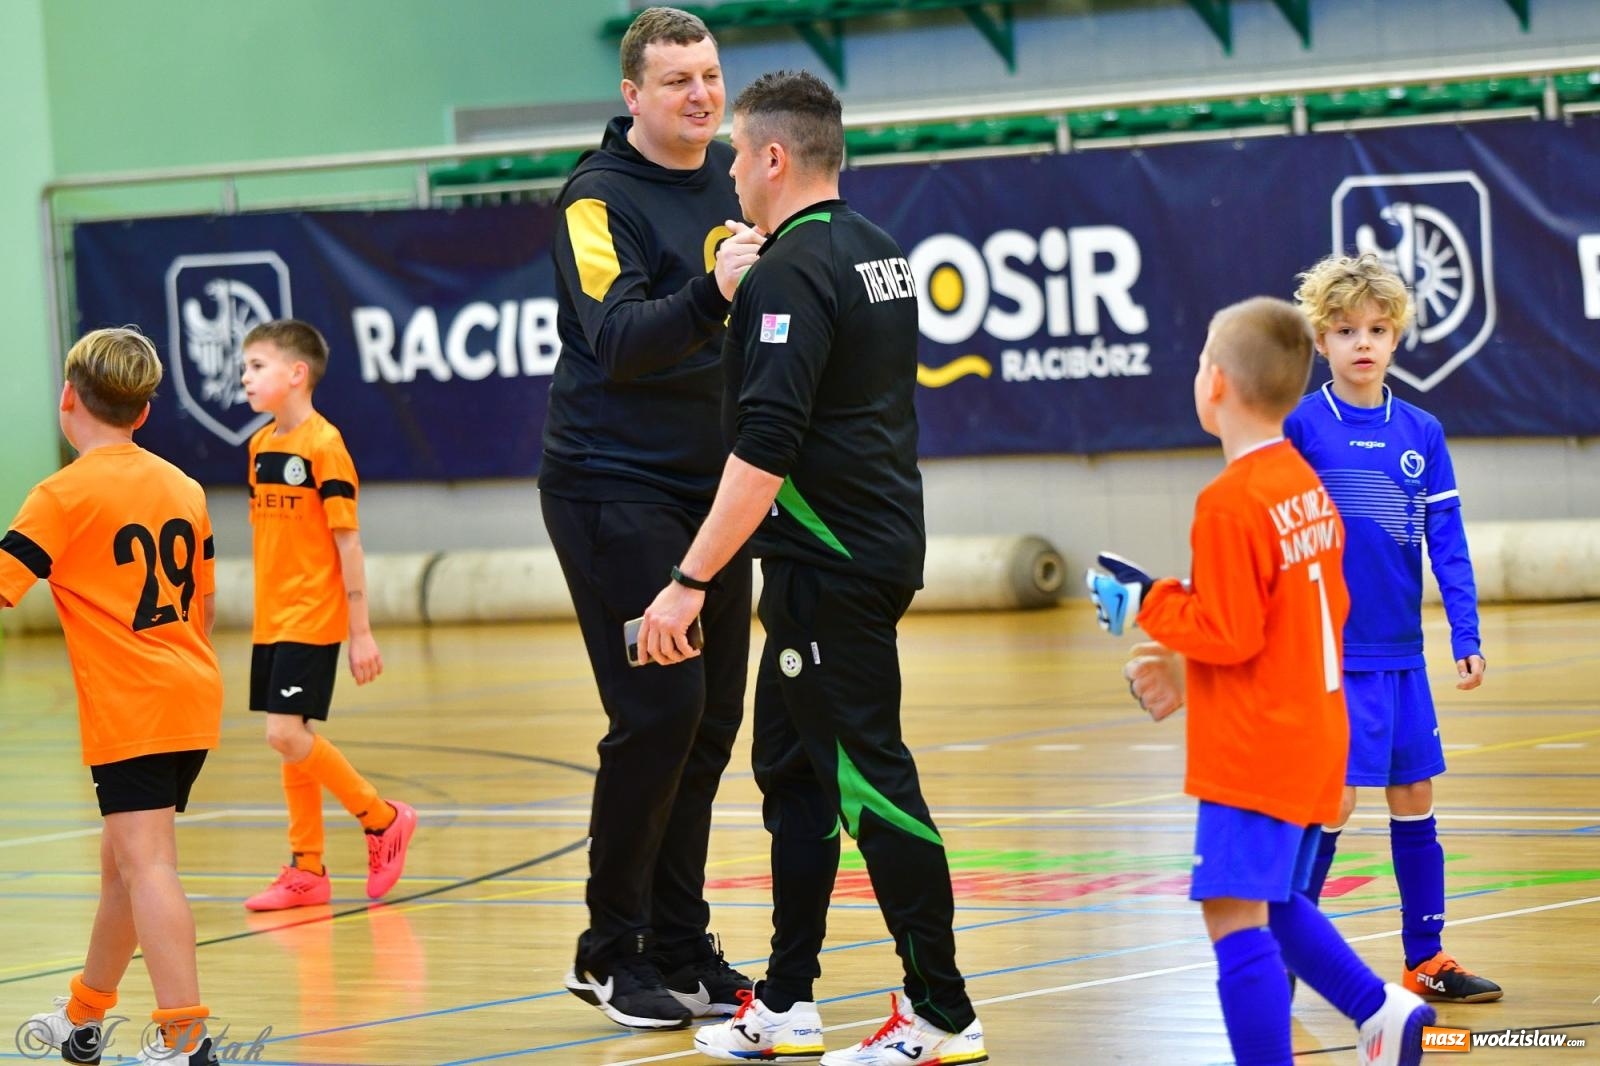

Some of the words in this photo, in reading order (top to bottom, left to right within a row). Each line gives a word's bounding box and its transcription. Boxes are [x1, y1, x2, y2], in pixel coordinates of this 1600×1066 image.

[854, 257, 917, 304] TRENER
[1001, 335, 1152, 383] RACIBÓRZ
[1349, 440, 1386, 449] regio
[1268, 495, 1304, 535] LKS
[113, 518, 196, 632] 29
[1307, 561, 1340, 693] 1
[1416, 972, 1446, 992] FILA
